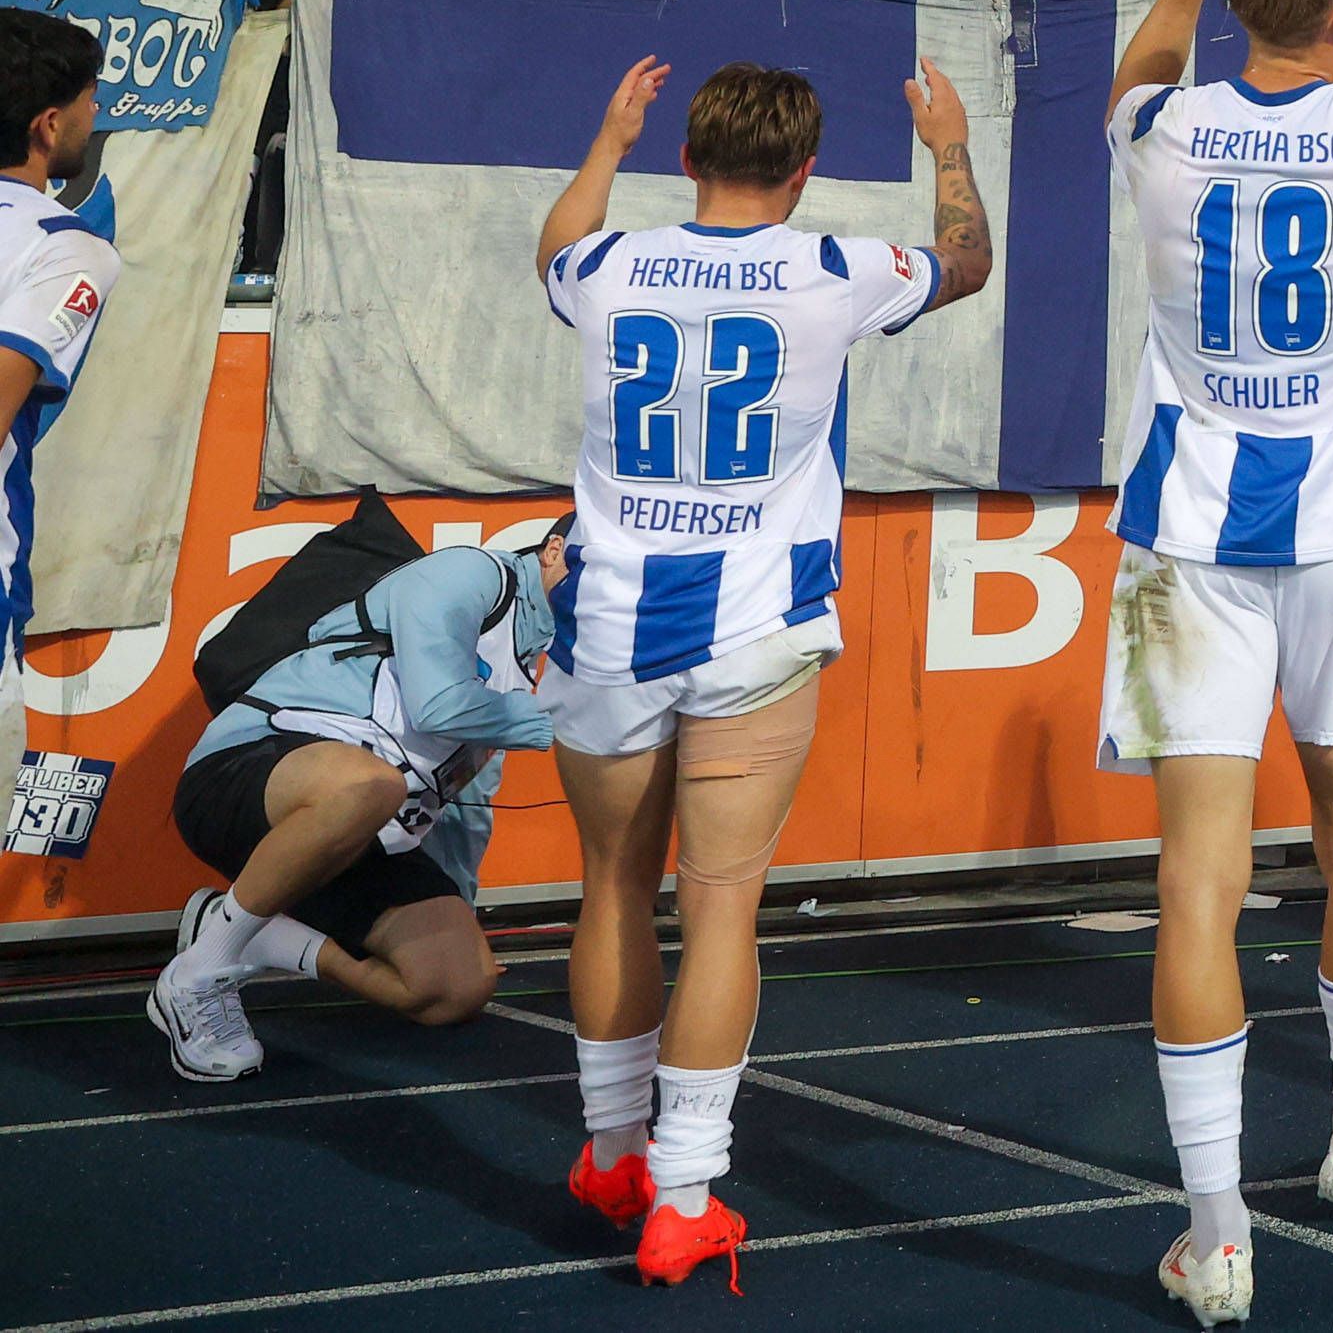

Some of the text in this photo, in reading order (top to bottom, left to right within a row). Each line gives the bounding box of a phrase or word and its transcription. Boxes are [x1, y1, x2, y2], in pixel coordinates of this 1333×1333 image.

[109, 91, 208, 123] Gruppe
[1190, 127, 1290, 164] HERTHA
[629, 256, 789, 292] HERTHA BSC
[605, 307, 786, 486] 22
[1202, 372, 1320, 407] SCHULER
[618, 495, 763, 535] PEDERSEN
